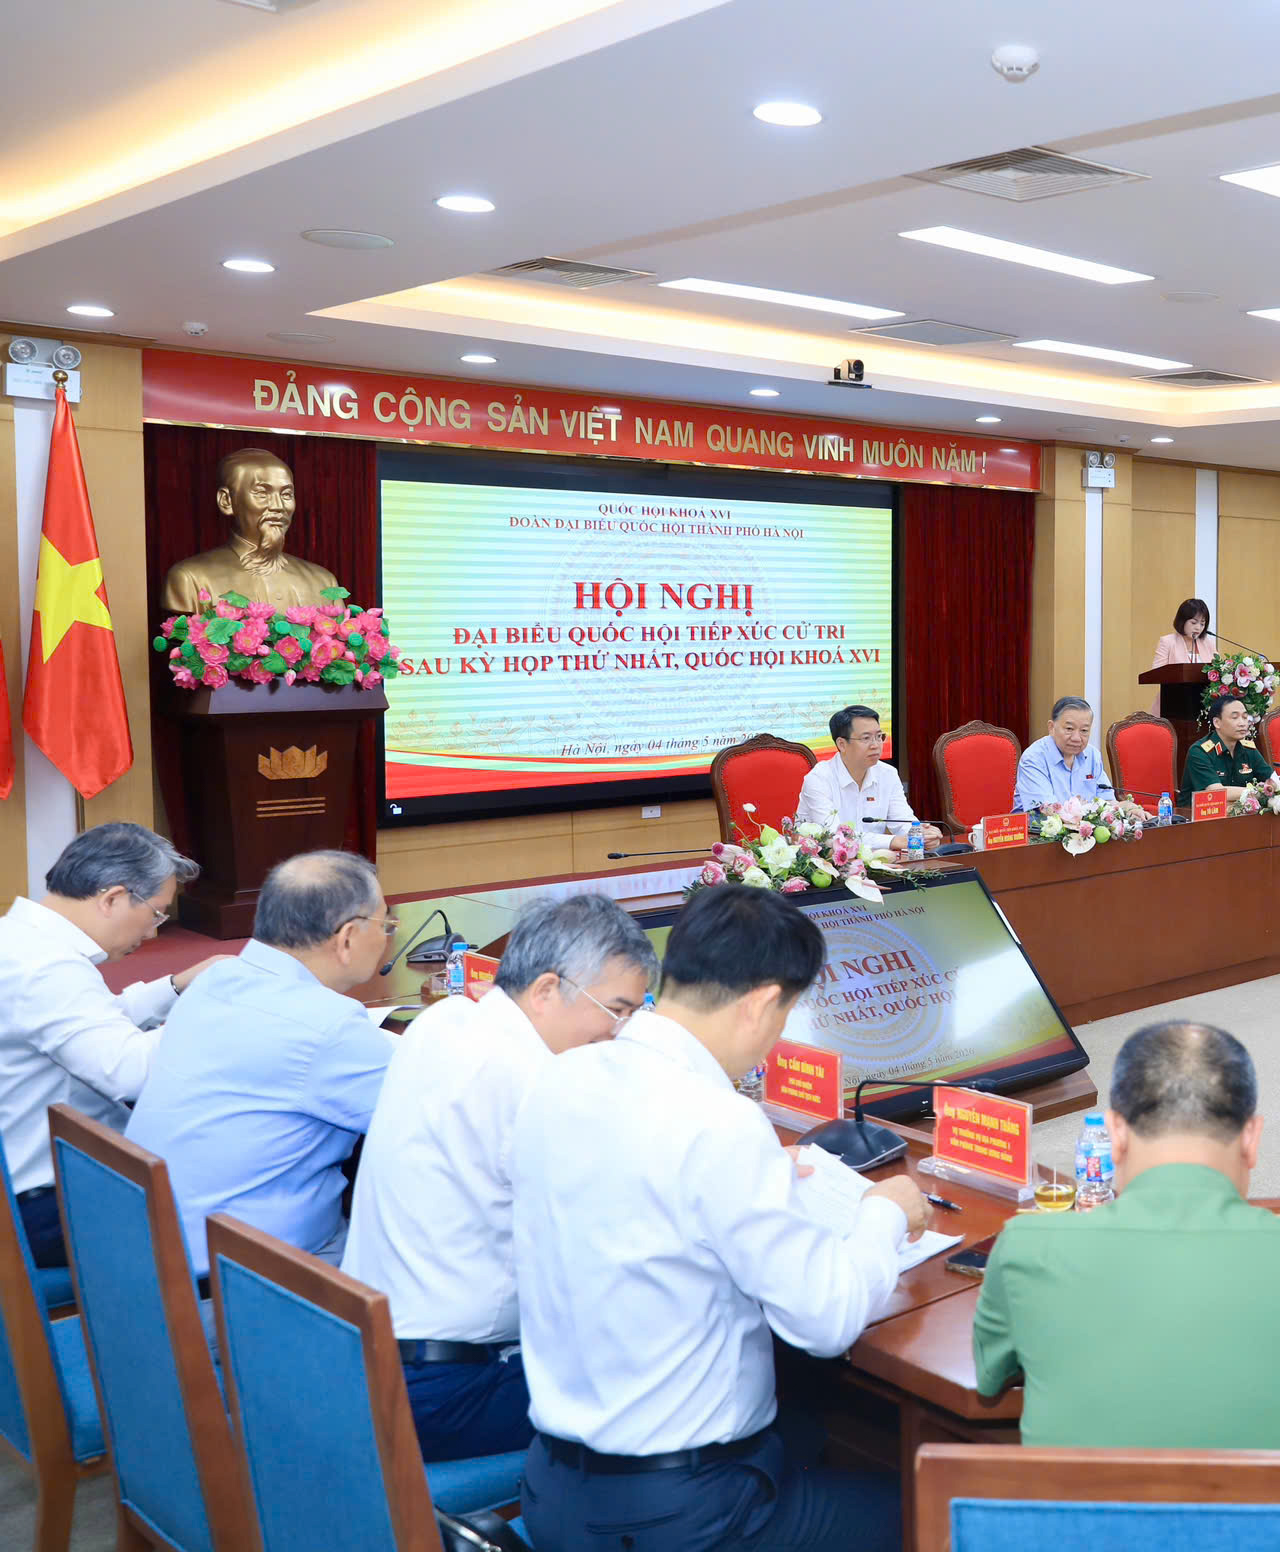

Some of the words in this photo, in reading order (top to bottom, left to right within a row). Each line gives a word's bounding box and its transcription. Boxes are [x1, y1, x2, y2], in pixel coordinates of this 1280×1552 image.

[253, 370, 360, 419] ĐẢNG
[373, 387, 472, 432] CỘNG
[487, 394, 549, 436] SẢN
[560, 406, 623, 445] VIỆT
[635, 416, 695, 448] NAM
[706, 424, 794, 458] QUANG
[802, 434, 855, 463] VINH
[862, 438, 925, 469] MUÔN
[932, 442, 977, 474] NĂM
[598, 502, 637, 516] QUỐC
[641, 505, 665, 518] HỘI
[669, 506, 706, 519] KHOÁ
[710, 509, 731, 520] XVI
[509, 515, 551, 529] ĐOÀN
[555, 519, 580, 531] ĐẠI
[584, 517, 616, 531] BIỂU
[619, 520, 658, 533] QUỐC
[662, 522, 685, 535] HỘI
[688, 522, 732, 536] THÀNH
[736, 525, 760, 537] PHỐ
[764, 526, 780, 537] HÀ
[783, 528, 804, 540] NỘI
[573, 578, 649, 617] HỘI
[659, 582, 755, 617] NGHỊ
[453, 627, 498, 649] ĐẠI
[506, 622, 561, 644] BIỂU
[568, 621, 635, 646] QUỐC
[641, 623, 680, 645] HỘI
[686, 620, 732, 641] TIẾP
[736, 620, 777, 641] XÚC
[782, 620, 811, 640] CỬ
[814, 624, 846, 639] TRI
[400, 657, 452, 676] SAU
[459, 651, 496, 675] KỲ
[503, 655, 554, 676] HỌP
[558, 649, 610, 671] THỨ
[615, 648, 680, 671] NHẤT,
[684, 647, 744, 670] QUỐC
[750, 648, 785, 669] HỘI
[790, 645, 845, 665] KHOÁ
[849, 648, 881, 663] XVI
[561, 743, 580, 756] Hà
[584, 742, 610, 756] Nội,
[615, 742, 643, 756] ngày
[647, 739, 662, 750] 04
[666, 737, 699, 750] tháng
[703, 736, 709, 747] 5
[712, 735, 737, 746] năm
[840, 914, 873, 927] THÀNH
[895, 908, 909, 918] HÀ
[909, 906, 925, 916] NỘI
[850, 905, 867, 914] XVI
[840, 950, 917, 980] NGHỊ
[842, 987, 874, 1003] HỘI
[873, 979, 910, 997] TIẾP
[910, 973, 942, 990] XÚC
[834, 1004, 883, 1024] NHẤT,
[883, 995, 928, 1016] QUỐC
[888, 1066, 899, 1076] 04
[901, 1060, 926, 1073] tháng
[927, 1057, 933, 1067] 5
